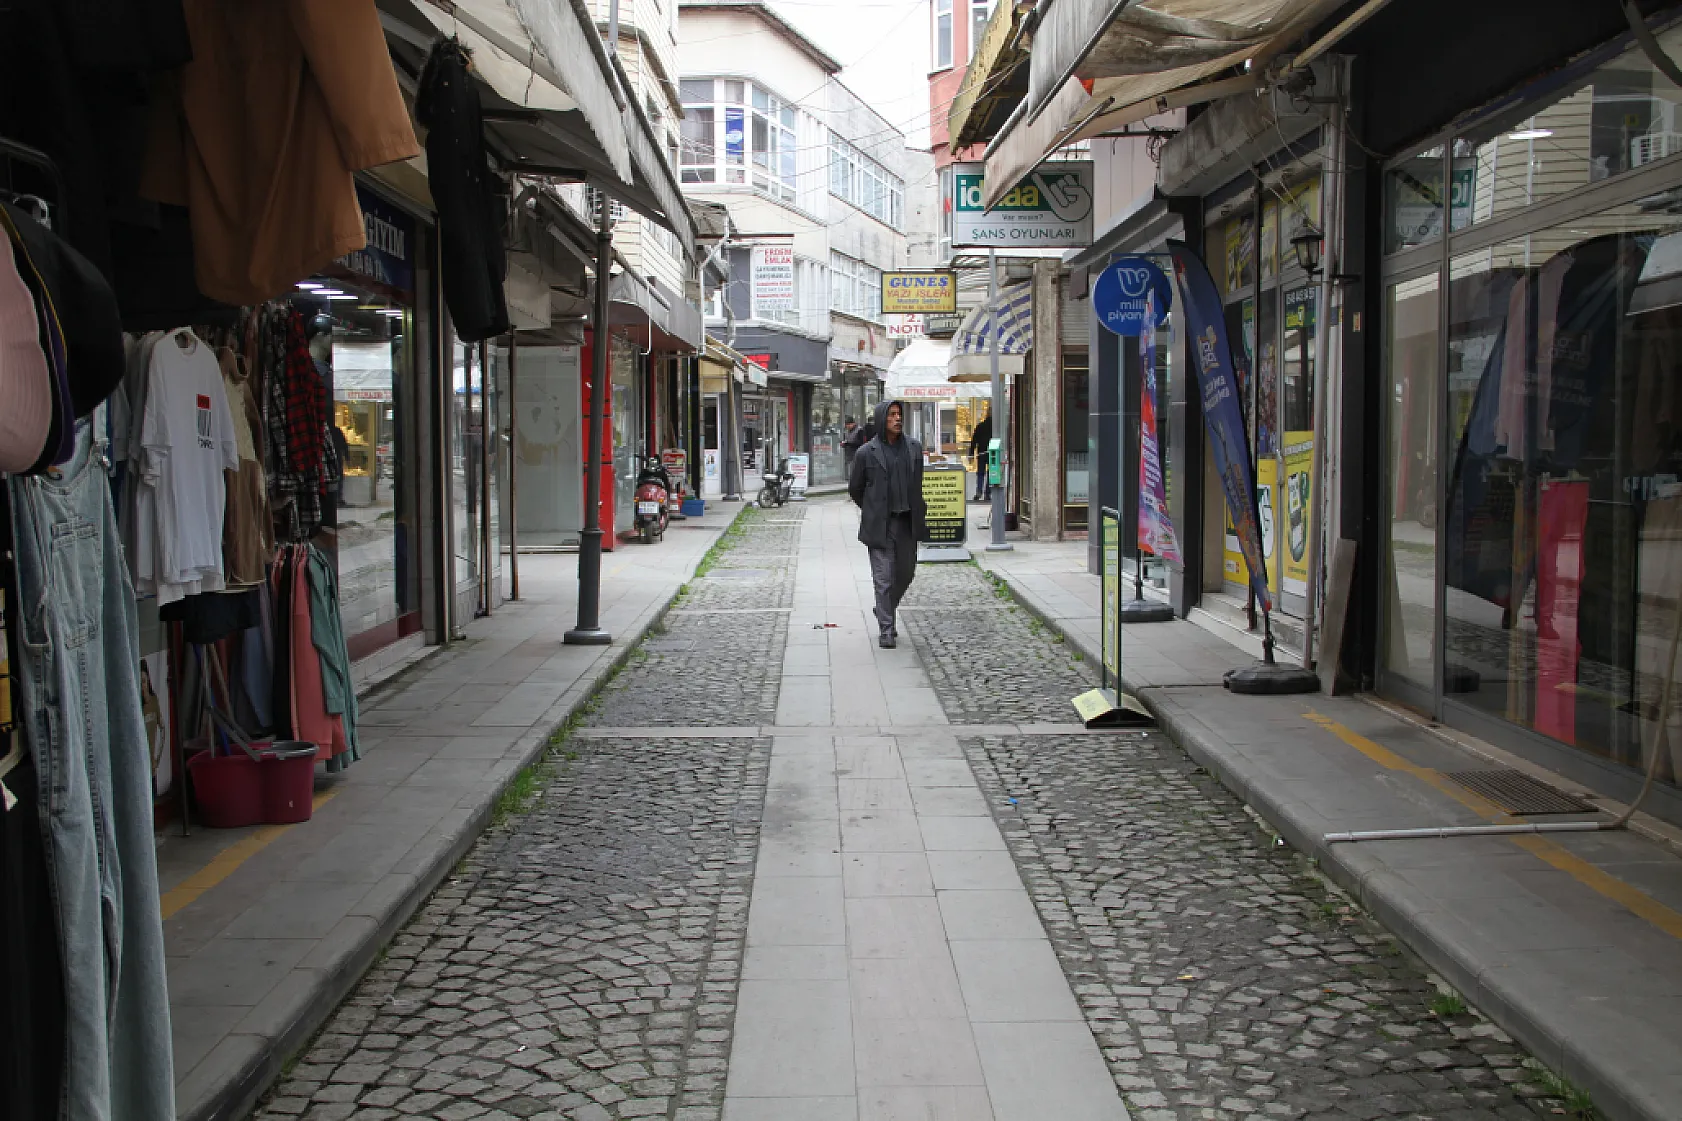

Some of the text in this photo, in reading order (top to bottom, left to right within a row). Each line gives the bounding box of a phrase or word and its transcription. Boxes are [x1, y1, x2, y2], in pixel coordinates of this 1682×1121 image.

[960, 179, 1039, 207] idaa
[972, 228, 1075, 240] ŞANS OYUNLARI
[765, 256, 792, 264] EMLAK
[887, 289, 912, 298] YAZI
